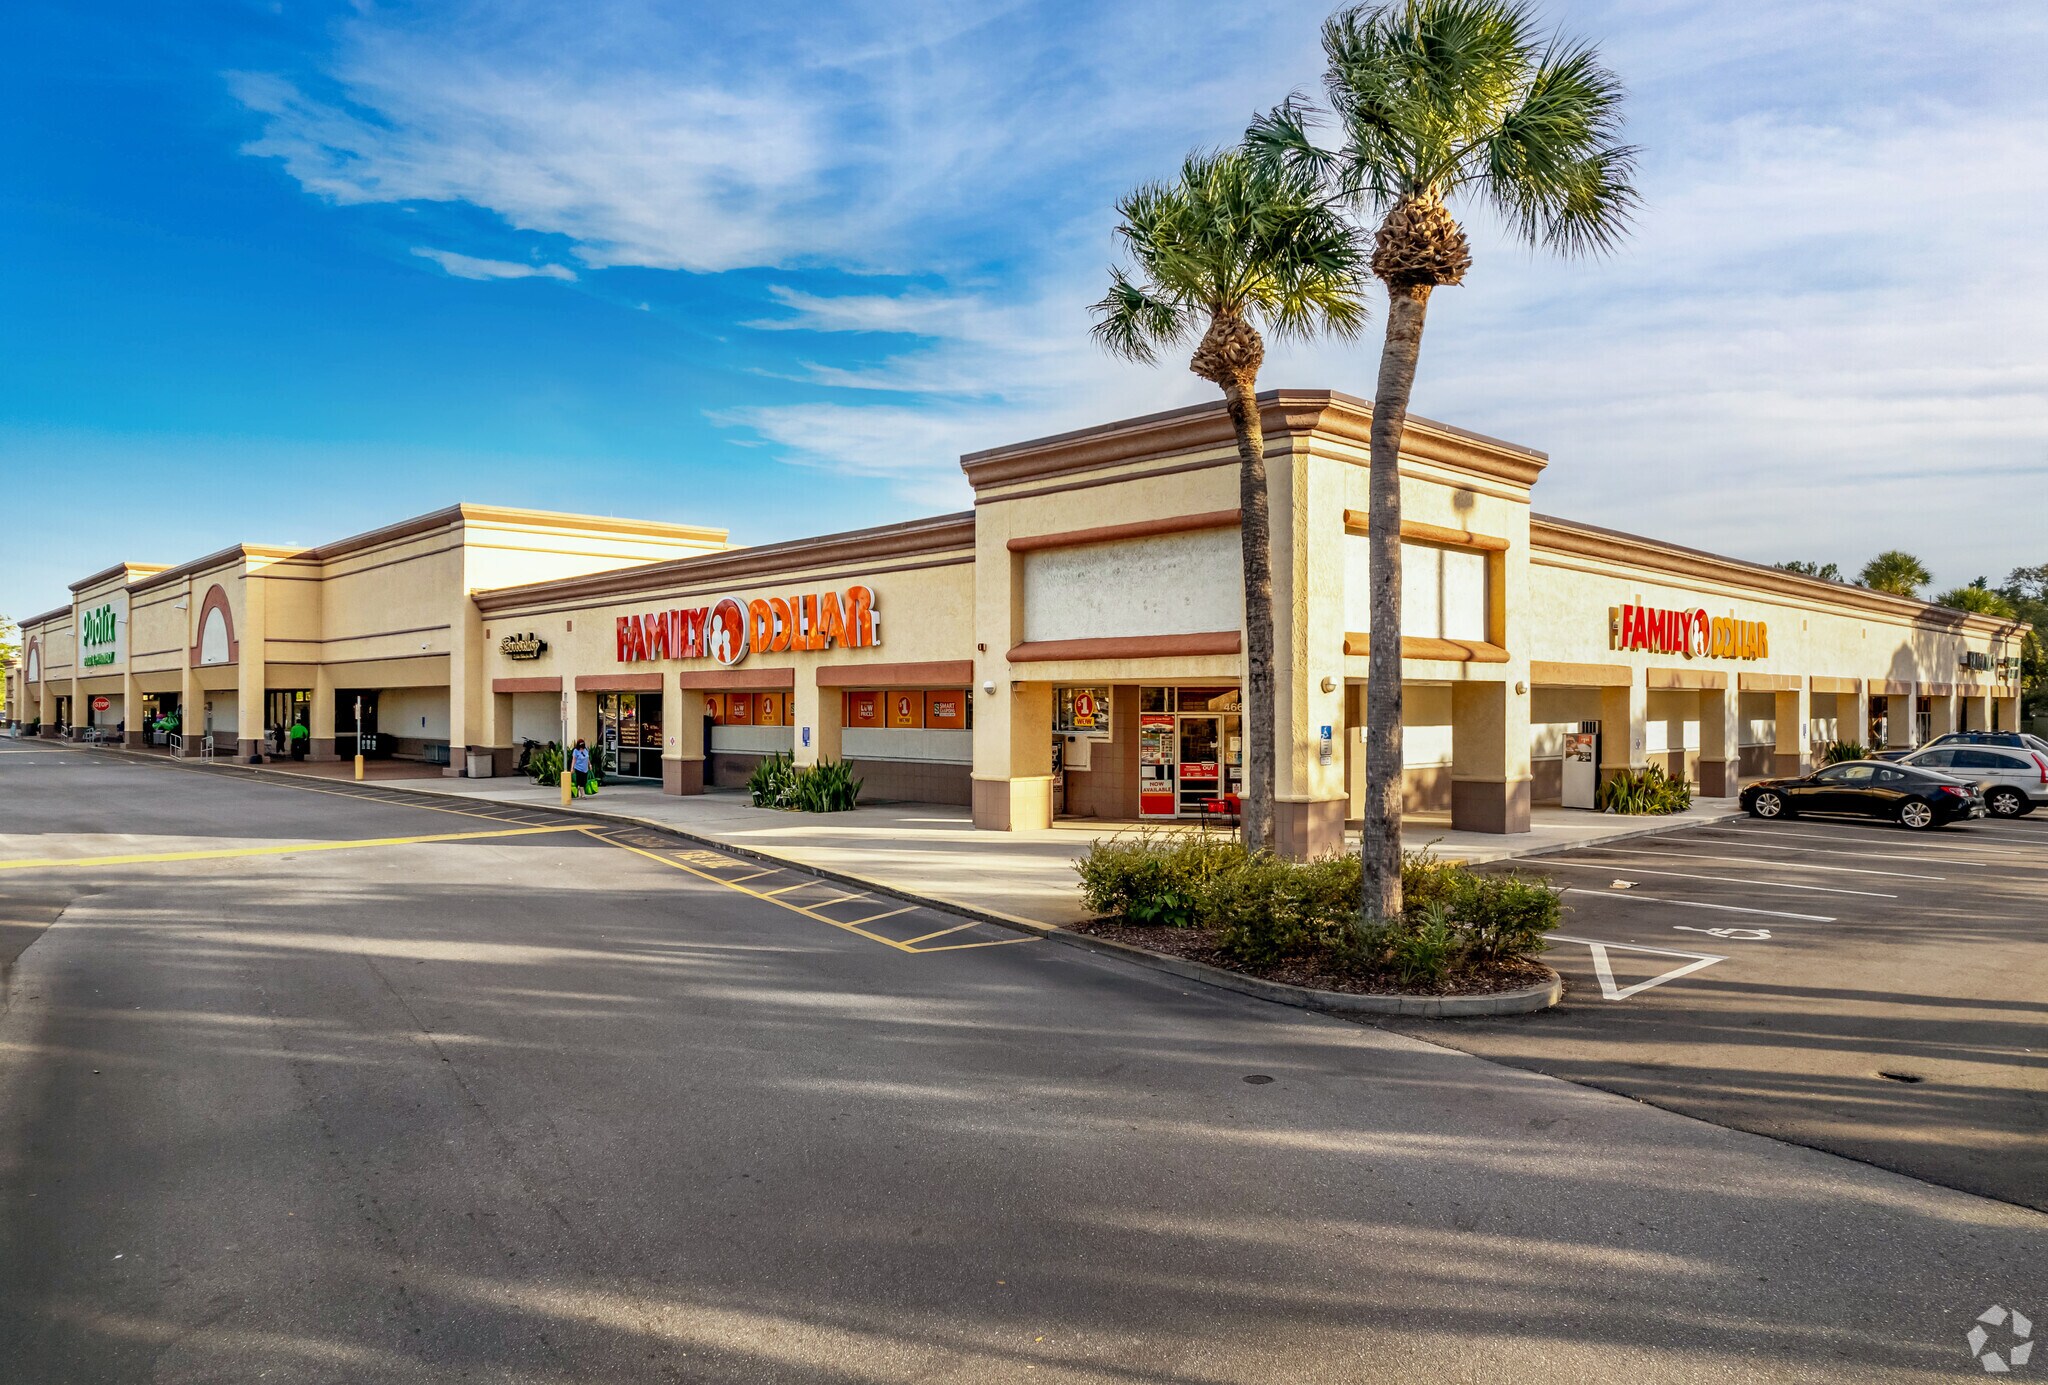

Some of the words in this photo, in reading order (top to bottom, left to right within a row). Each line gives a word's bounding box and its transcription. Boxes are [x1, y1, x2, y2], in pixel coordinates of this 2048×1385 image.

[83, 603, 116, 646] Publix
[616, 606, 710, 663] FAMILY
[749, 585, 876, 654] DOLLAR
[1622, 604, 1693, 653] FAMILY
[1711, 616, 1769, 659] DOLLAR
